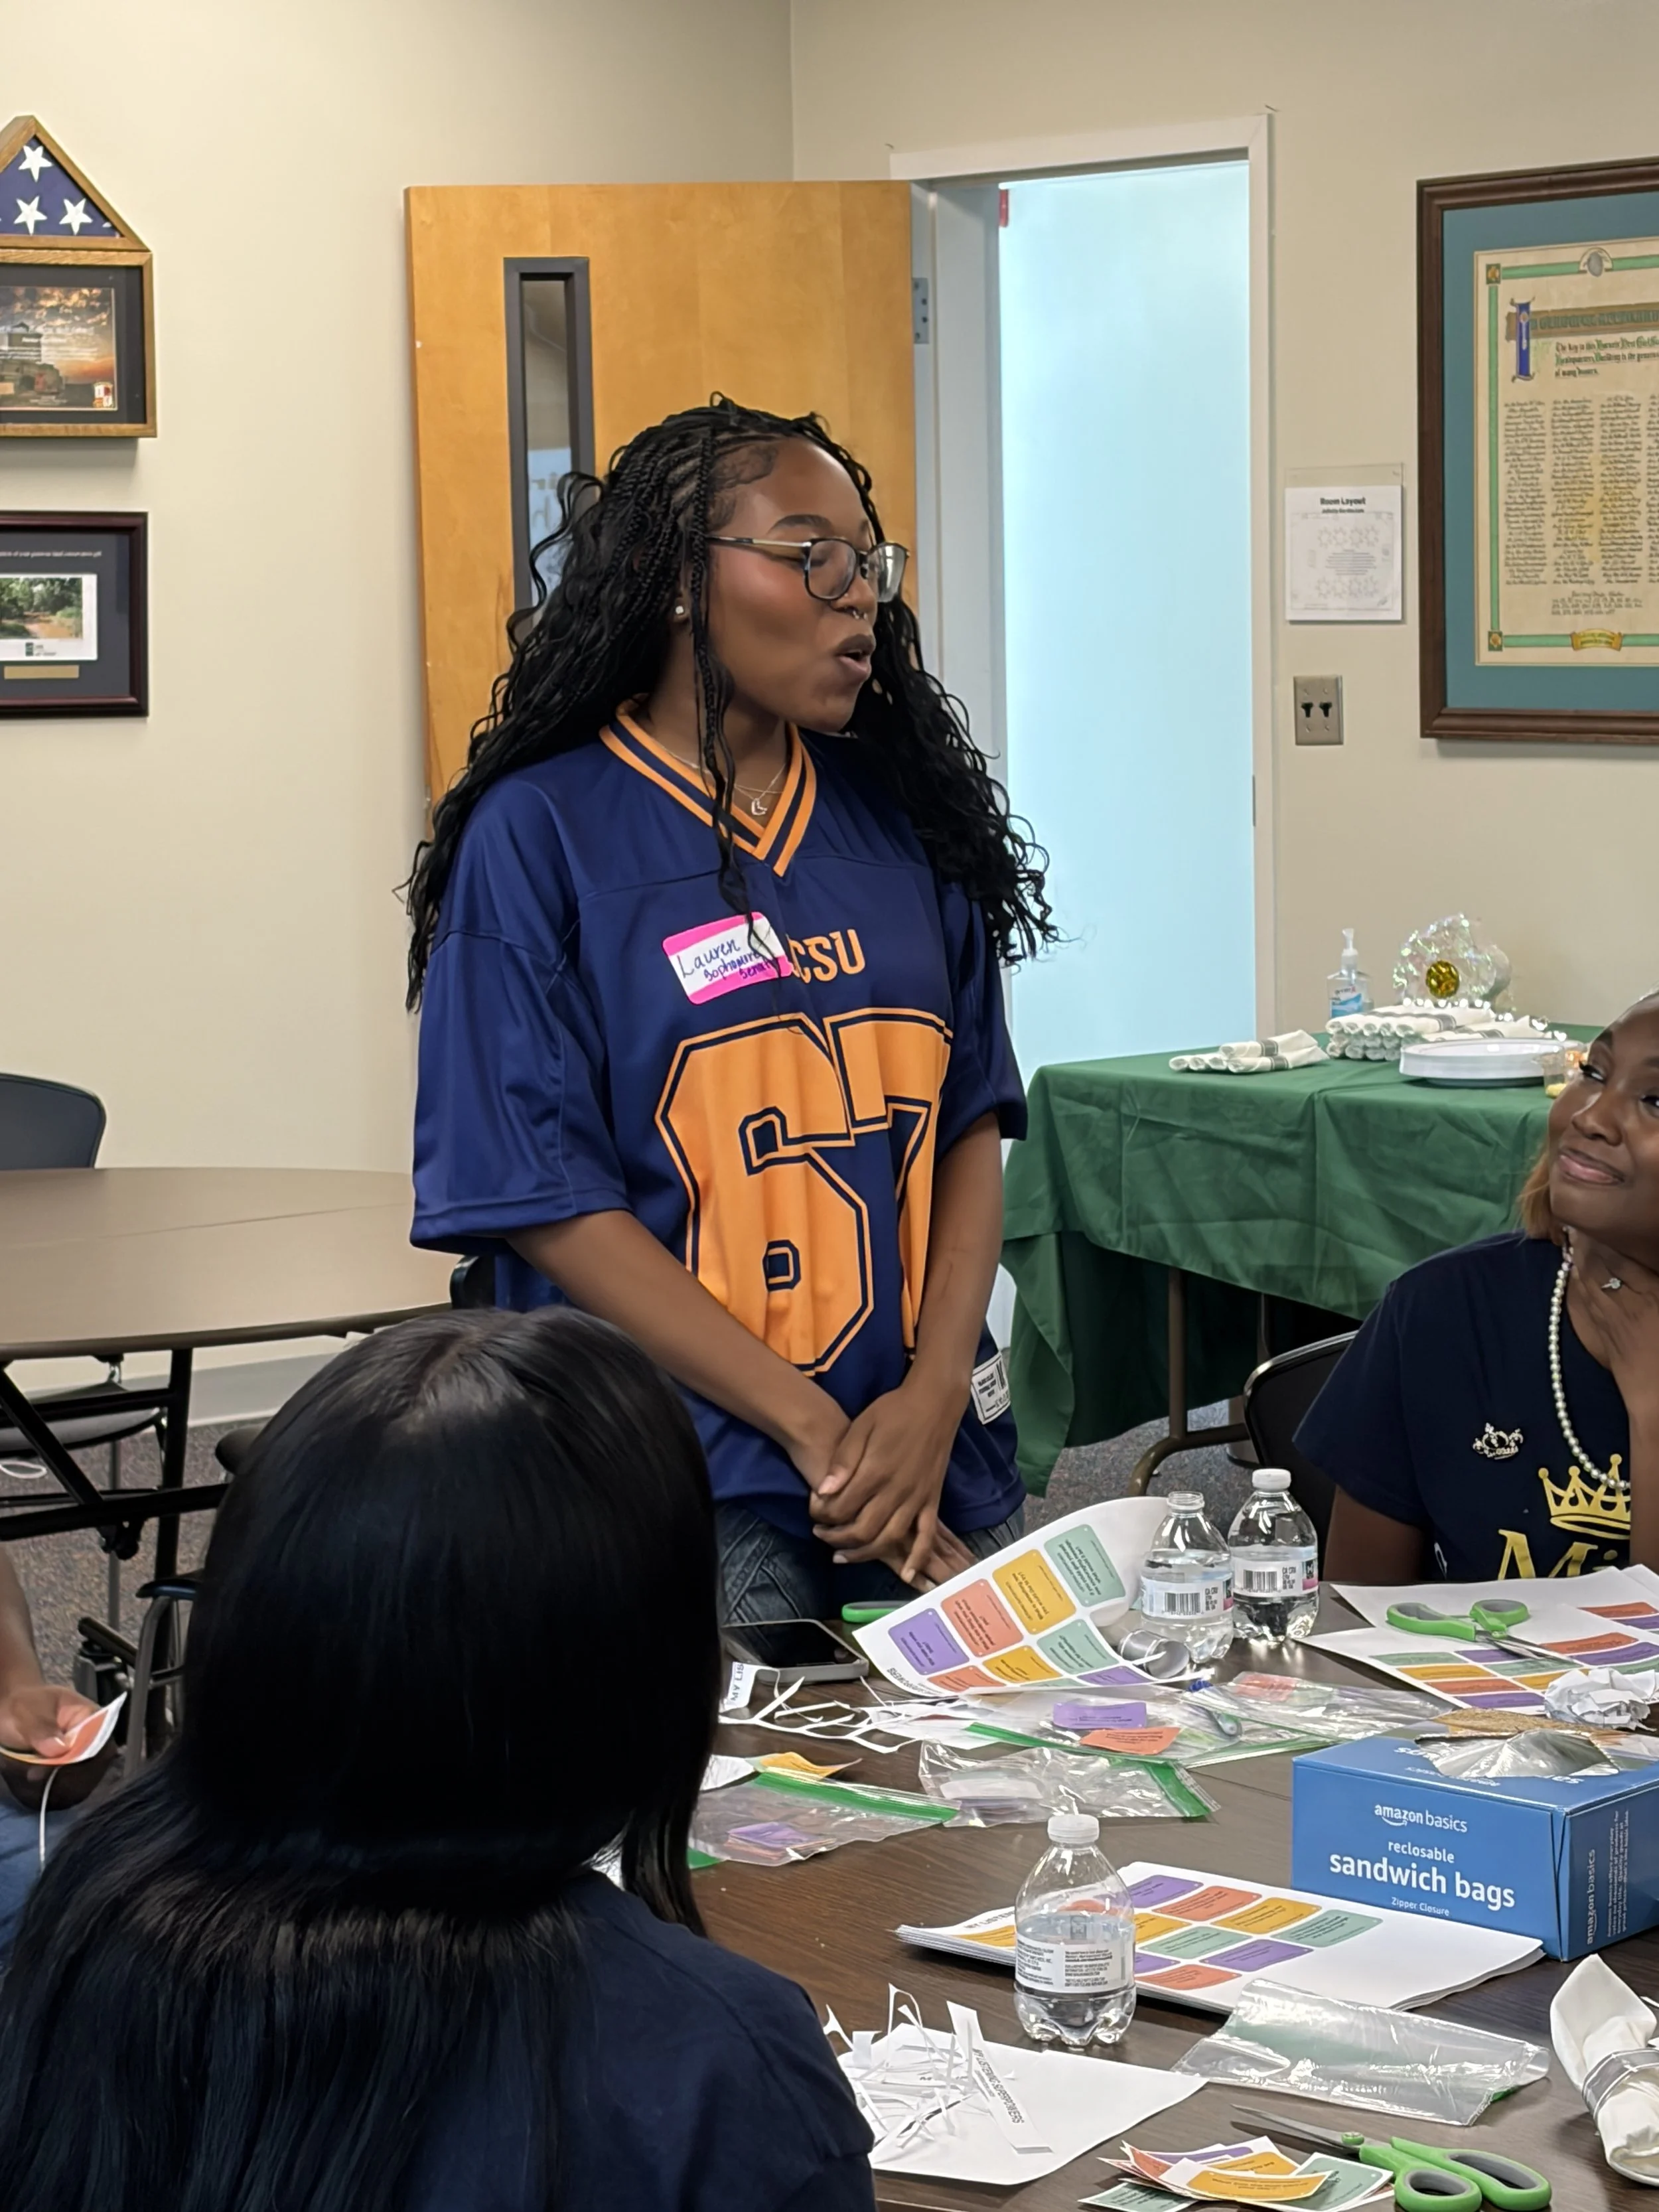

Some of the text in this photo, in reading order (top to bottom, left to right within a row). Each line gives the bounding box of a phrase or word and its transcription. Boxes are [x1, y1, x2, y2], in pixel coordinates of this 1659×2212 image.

[1341, 496, 1366, 506] Layout
[676, 938, 741, 978] Lauren
[654, 1007, 953, 1377] 67
[730, 1685, 740, 1700] MY
[1374, 1805, 1467, 1832] amazon basics
[1388, 1840, 1455, 1864] reclosable
[1329, 1853, 1515, 1911] sandwich bags
[1587, 1849, 1595, 1891] basics
[1391, 1896, 1449, 1916] Zipper Closure
